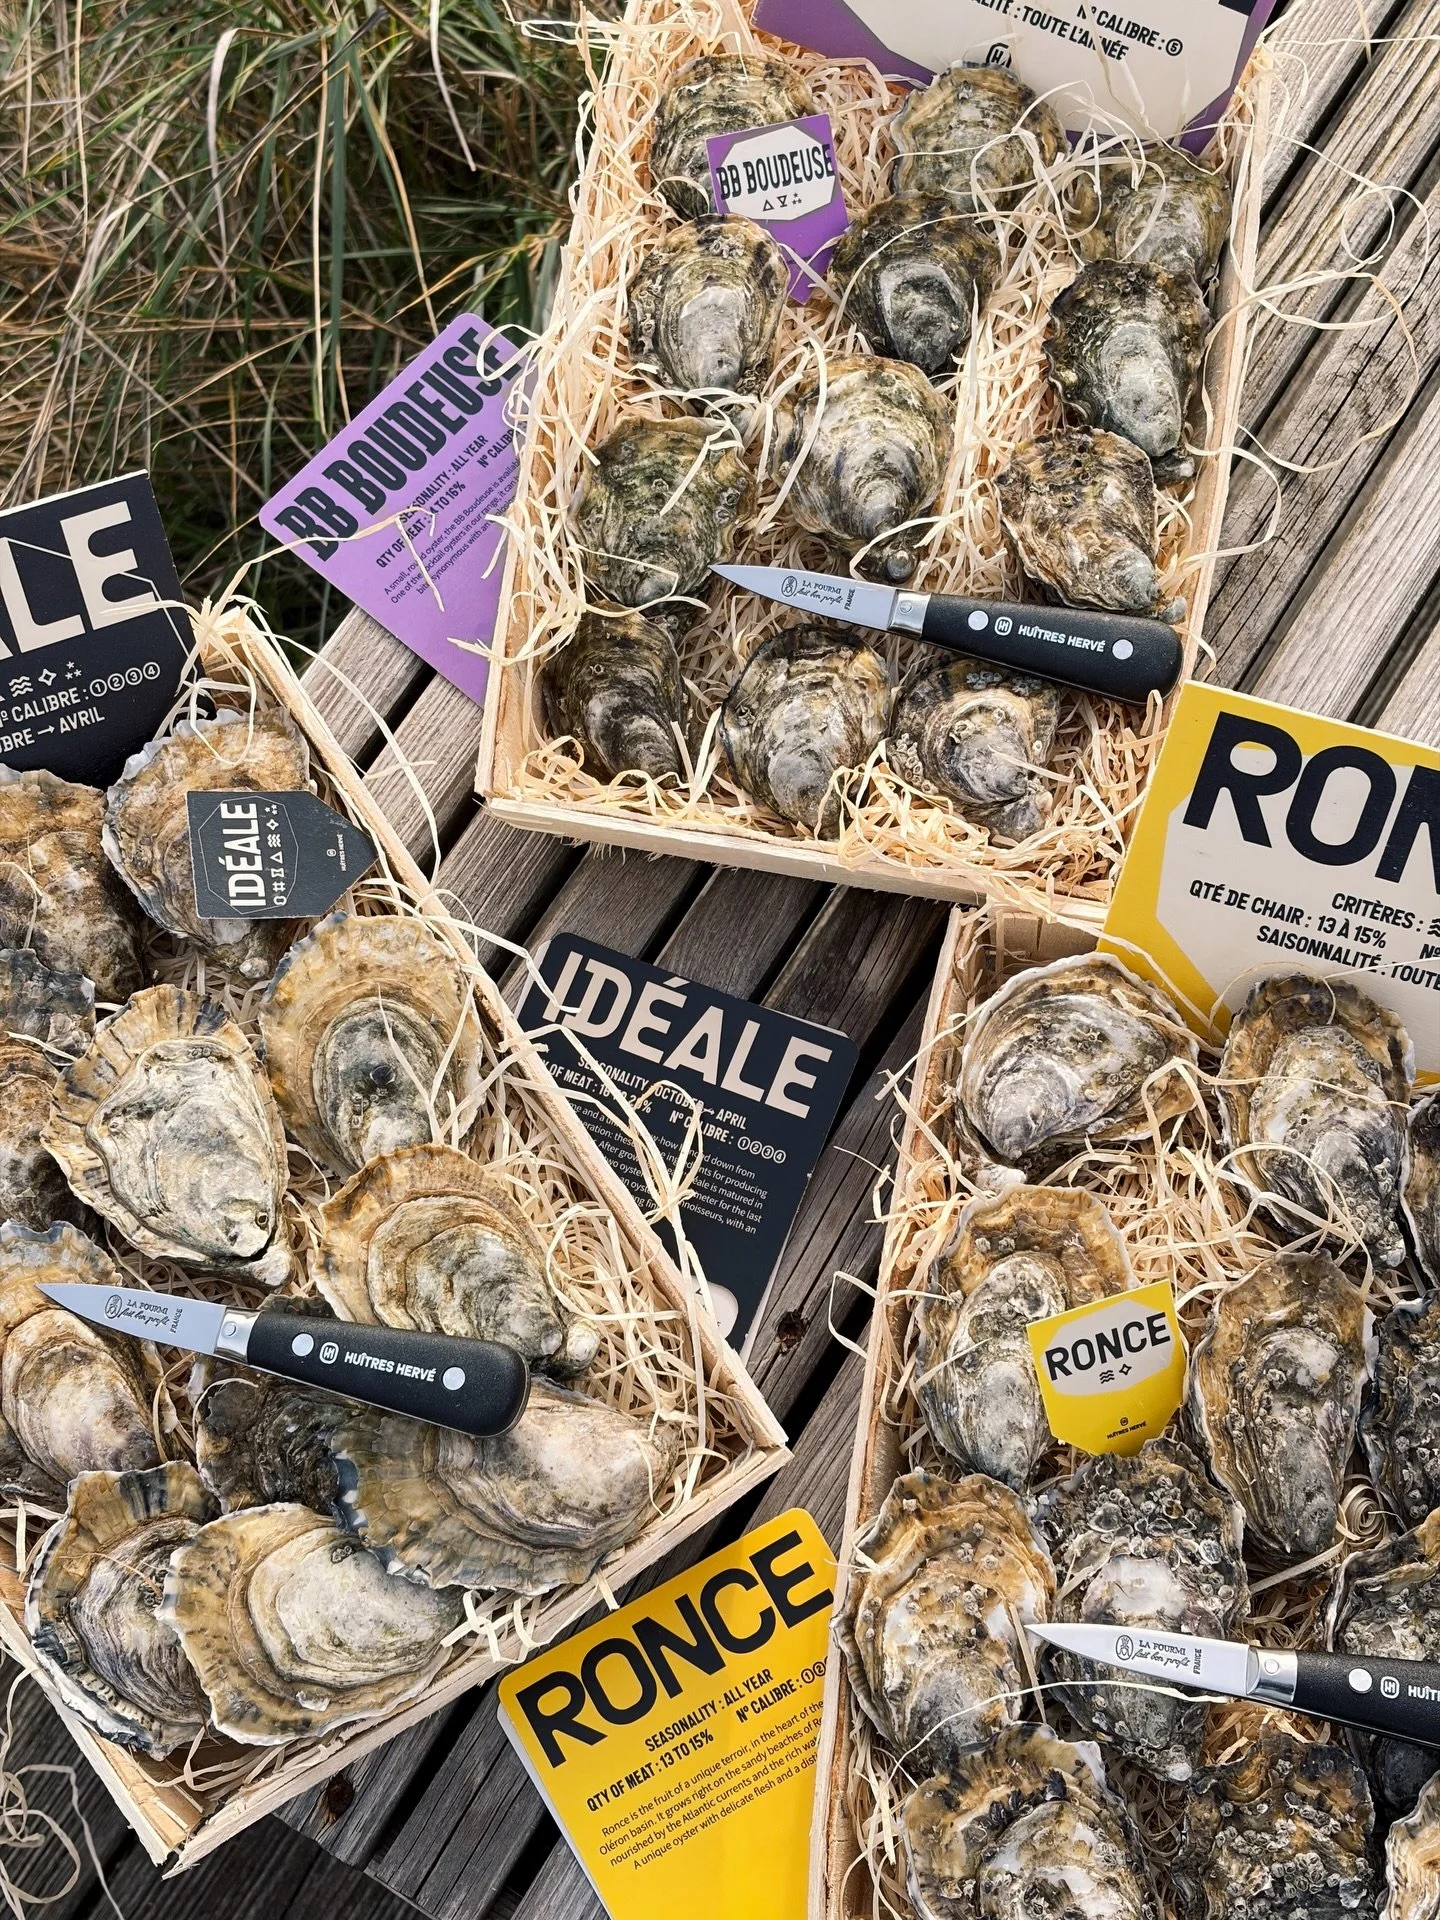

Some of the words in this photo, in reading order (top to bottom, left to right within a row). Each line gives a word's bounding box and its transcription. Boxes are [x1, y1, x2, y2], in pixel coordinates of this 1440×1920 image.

[1023, 5, 1070, 38] TOUTE
[1096, 10, 1160, 48] CALIBRE
[716, 164, 742, 200] BB
[743, 144, 835, 194] BOUDEUSE
[274, 486, 358, 562] BB
[321, 328, 522, 515] BOUDEUSE
[451, 455, 469, 472] ALL
[463, 435, 488, 457] YEAR
[376, 548, 395, 568] QTY
[392, 538, 405, 552] OF
[434, 496, 450, 510] TO
[446, 481, 466, 499] 16%
[389, 571, 410, 590] small,
[444, 524, 456, 535] the
[453, 514, 465, 525] BB
[463, 487, 494, 517] Boudeuse
[391, 590, 406, 603] One
[410, 573, 423, 584] the
[425, 550, 446, 573] ocktail
[444, 530, 466, 552] oysters
[471, 513, 482, 525] our
[504, 480, 516, 492] can
[468, 530, 482, 544] with
[1017, 623, 1066, 644] HUÎTRES
[1066, 634, 1105, 652] HERVÉ
[12, 687, 81, 722] CALIBRE
[59, 706, 105, 734] AVRIL
[218, 803, 267, 906] IDÉALE
[1189, 879, 1225, 903] QTÉ
[1225, 888, 1248, 910] DE
[1251, 897, 1304, 925] CHAIR
[1317, 915, 1337, 934] 13
[1336, 918, 1351, 938] À
[1353, 925, 1387, 949] 15%
[1331, 893, 1416, 930] CRITÈRES
[1256, 925, 1381, 974] SAISONNALITÉ
[542, 951, 833, 1119] IDÉALE
[564, 1069, 593, 1089] MEAT
[682, 1115, 729, 1142] CIBRE
[577, 1054, 648, 1091] SEONALITY
[716, 1109, 746, 1129] APRIL
[582, 1109, 599, 1119] and
[711, 1157, 734, 1171] down
[735, 1165, 755, 1179] from
[598, 1141, 619, 1153] After
[718, 1188, 755, 1206] matured
[713, 1170, 725, 1181] for
[724, 1177, 768, 1199] producing
[718, 1200, 731, 1210] for
[732, 1205, 746, 1216] the
[746, 1210, 762, 1223] last
[726, 1218, 744, 1229] with
[343, 1349, 395, 1372] HUÎTRES
[394, 1362, 436, 1382] HERVÉ
[1045, 1311, 1171, 1381] RONCE
[515, 1531, 834, 1768] RONCE
[1138, 1639, 1151, 1648] LA
[1152, 1642, 1186, 1655] FOURMI
[1191, 1648, 1203, 1674] FRANCE
[587, 1789, 610, 1811] QTY
[610, 1780, 624, 1798] OF
[625, 1762, 655, 1789] MEAT
[660, 1752, 674, 1768] 13
[672, 1743, 690, 1760] TO
[689, 1729, 714, 1751] 15%
[750, 1679, 797, 1714] CALIBRE
[645, 1700, 717, 1752] SEASONALITY
[723, 1686, 745, 1706] ALL
[742, 1669, 773, 1693] YEAR
[600, 1834, 630, 1855] Oléron
[629, 1820, 657, 1837] basin.
[656, 1812, 665, 1821] It
[665, 1797, 692, 1819] grows
[692, 1783, 714, 1801] right
[713, 1777, 725, 1788] on
[725, 1768, 741, 1780] the
[741, 1751, 767, 1771] sandy
[766, 1730, 803, 1755] beaches
[804, 1721, 813, 1733] of
[602, 1817, 630, 1837] Ronce
[630, 1812, 639, 1821] is
[638, 1803, 654, 1815] the
[654, 1790, 674, 1806] fruit
[674, 1782, 683, 1794] of
[691, 1762, 721, 1784] unique
[721, 1745, 751, 1766] terroir,
[750, 1739, 760, 1748] in
[760, 1730, 776, 1742] the
[775, 1715, 800, 1733] heart
[800, 1707, 809, 1719] of
[809, 1701, 823, 1713] the
[610, 1834, 654, 1866] nourished
[653, 1829, 666, 1840] by
[666, 1820, 682, 1832] the
[682, 1799, 716, 1824] Atlantic
[716, 1778, 752, 1803] currents
[752, 1765, 769, 1781] and
[769, 1758, 785, 1770] the
[785, 1747, 802, 1762] rich
[641, 1843, 672, 1865] unique
[673, 1826, 698, 1846] oyster
[699, 1813, 720, 1829] with
[720, 1793, 754, 1817] delicate
[753, 1780, 776, 1797] flesh
[776, 1767, 794, 1784] and
